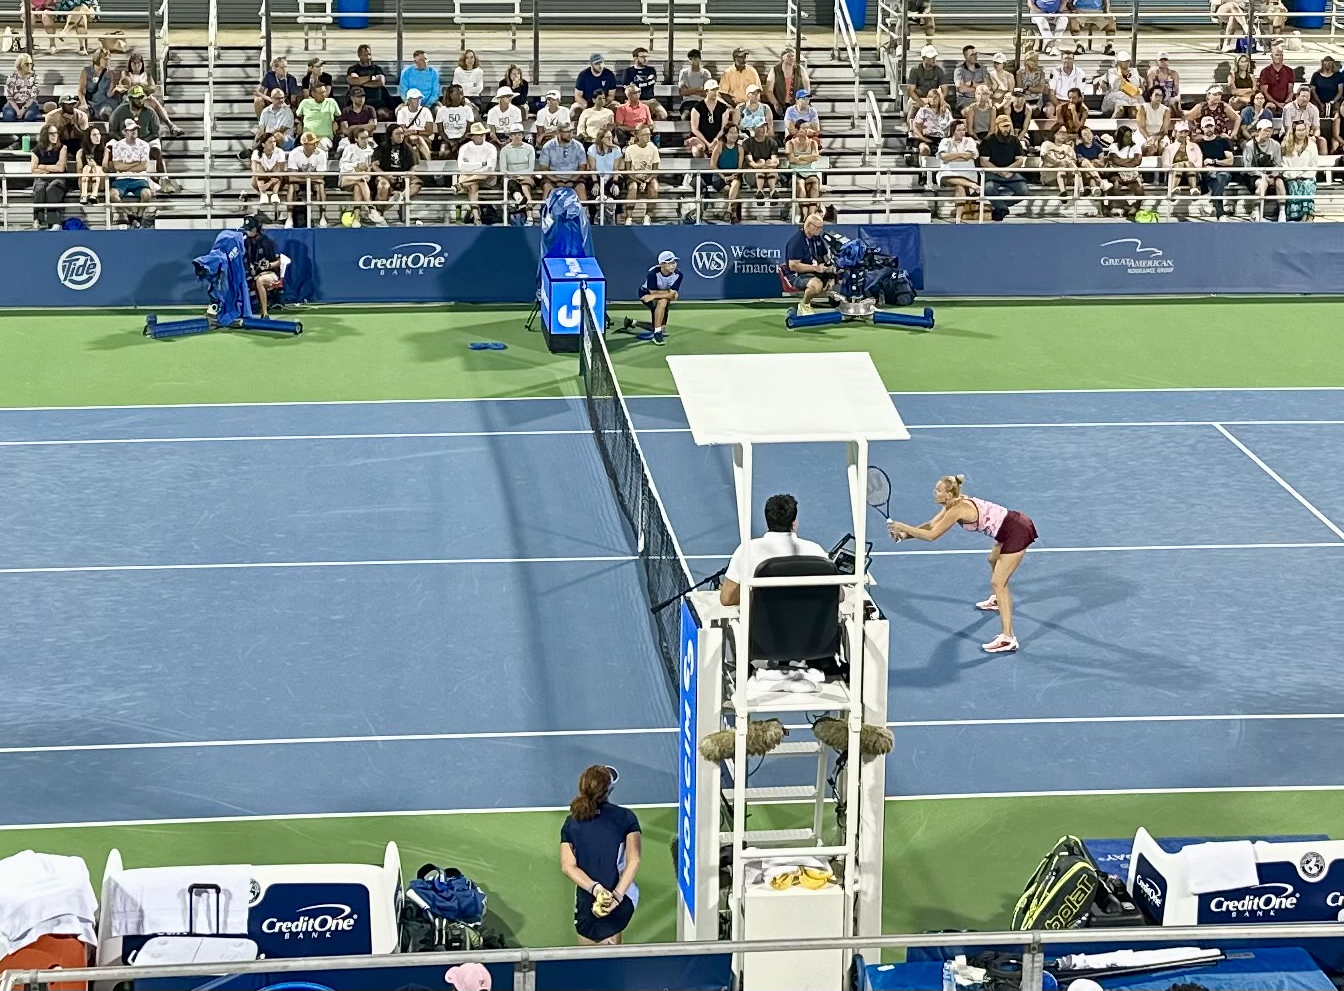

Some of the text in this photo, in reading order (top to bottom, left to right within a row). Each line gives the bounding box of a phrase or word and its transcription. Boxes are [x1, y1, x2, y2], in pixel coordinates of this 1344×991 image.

[731, 245, 781, 259] Western
[358, 252, 445, 270] CreditOne
[733, 260, 779, 274] Financi
[61, 256, 98, 282] Tide
[379, 268, 424, 276] BANK
[1210, 892, 1297, 913] CreditOne
[1230, 909, 1276, 918] BANK
[262, 914, 356, 934] CreditOne
[284, 930, 332, 940] BANK
